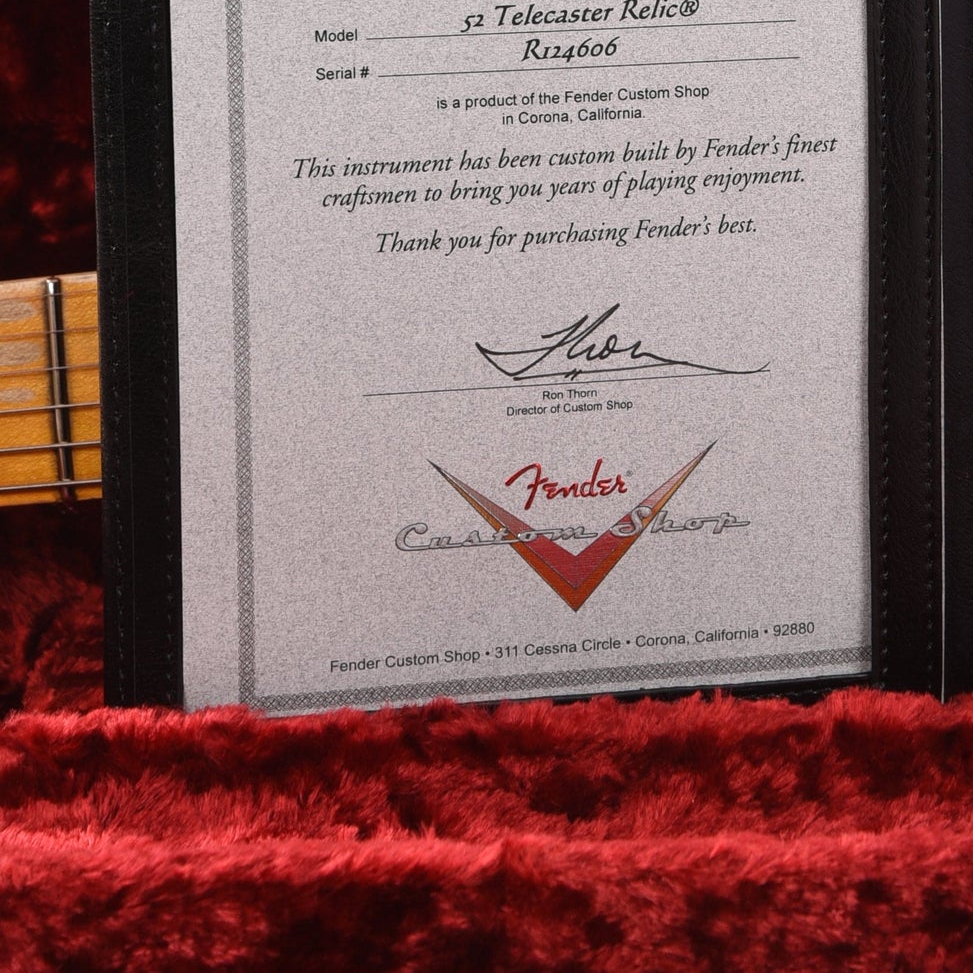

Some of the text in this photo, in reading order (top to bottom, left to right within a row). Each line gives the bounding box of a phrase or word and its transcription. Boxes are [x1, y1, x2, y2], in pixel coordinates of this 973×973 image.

[315, 29, 358, 42] Model
[460, 14, 484, 33] 52
[495, 4, 614, 26] Telecaster
[316, 36, 619, 81] Serial # R124606
[437, 86, 709, 111] is a product of the Fender Custom Shop
[503, 108, 645, 124] in Corona, California.
[294, 157, 336, 178] This
[343, 157, 453, 176] instrument
[459, 150, 491, 170] has
[498, 148, 541, 168] been
[549, 150, 614, 166] custom
[623, 140, 669, 162] built
[676, 139, 697, 166] by
[785, 134, 838, 161] finest
[322, 167, 804, 212] craftsmen to bring you years of playing enjoyment.
[377, 229, 442, 253] Thank
[445, 236, 482, 255] you
[484, 226, 517, 253] for
[520, 222, 629, 252] purchasing
[718, 214, 756, 234] best.
[507, 400, 633, 416] Director of Custom Shop
[543, 389, 597, 400] Ron Thorn
[394, 505, 750, 552] Custom Shop
[331, 622, 814, 672] Fender Custom Shop 311 Cessna Circle Corona, California 92880
